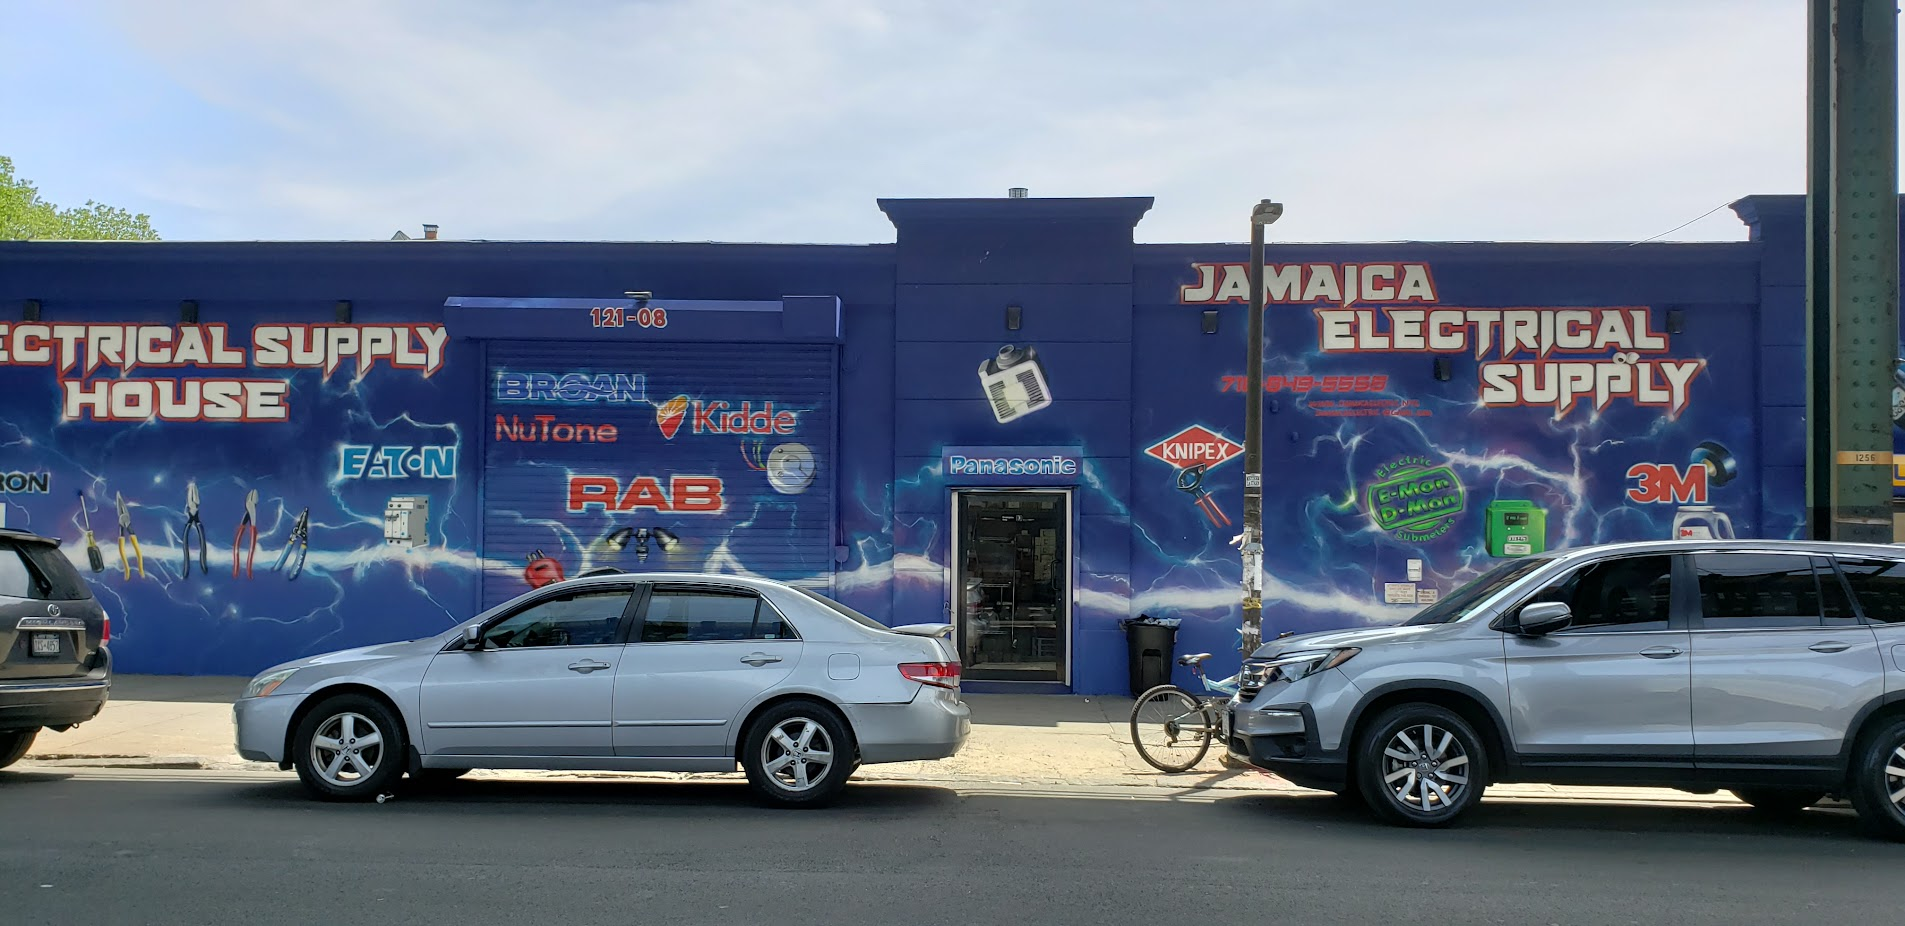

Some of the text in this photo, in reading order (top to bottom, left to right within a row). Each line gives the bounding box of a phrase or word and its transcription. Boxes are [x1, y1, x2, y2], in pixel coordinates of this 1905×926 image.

[1181, 262, 1438, 307] JAMAICA
[590, 307, 667, 328] 121-08
[1314, 306, 1669, 360] ELECTRICAL
[0, 322, 448, 381] CTRICAL SUPPLY
[61, 377, 290, 422] HOUSE
[497, 373, 646, 402] BROAN
[1477, 358, 1705, 420] SUPPLY
[496, 414, 618, 443] NuTone
[693, 401, 797, 435] Kidde
[340, 445, 457, 478] EATON
[949, 455, 1076, 475] Panasonic
[1162, 442, 1229, 461] KNIPEX
[1855, 454, 1876, 462] 1256
[1376, 456, 1432, 478] Electric
[0, 471, 51, 494] ON
[567, 475, 725, 514] RAB
[1377, 478, 1450, 505] E-Mon
[1626, 463, 1707, 504] 3M
[1380, 494, 1457, 524] D-Mon
[1396, 517, 1455, 542] Submeters
